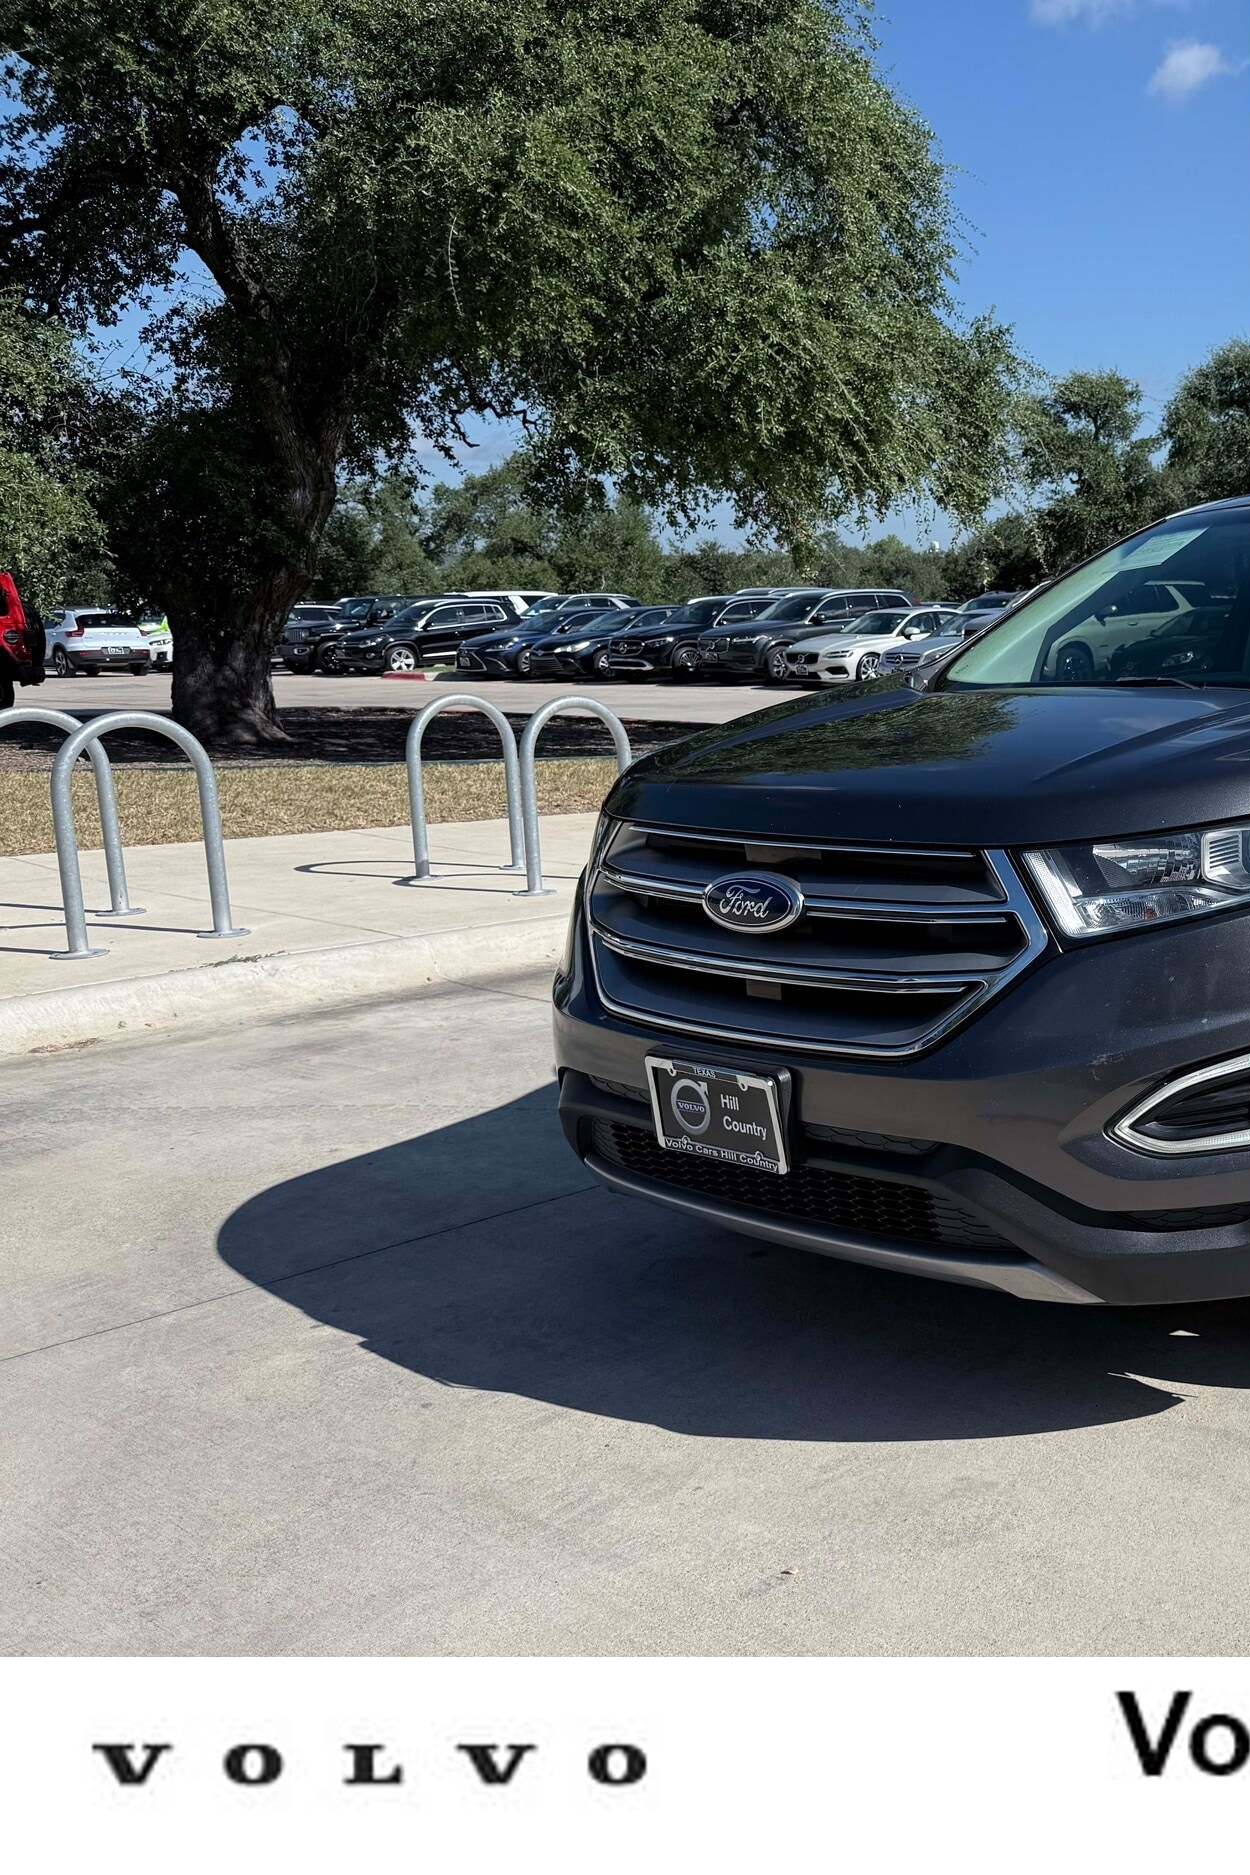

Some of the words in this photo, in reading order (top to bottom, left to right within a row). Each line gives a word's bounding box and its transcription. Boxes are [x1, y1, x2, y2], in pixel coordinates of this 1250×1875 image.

[720, 885, 772, 917] Ford
[693, 1068, 716, 1078] TEXAS
[678, 1102, 705, 1112] VOLVO
[720, 1094, 739, 1110] Hill
[723, 1116, 766, 1140] Country
[665, 1139, 693, 1151] Volvo
[695, 1145, 718, 1157] Cars
[721, 1150, 736, 1161] Hill
[740, 1155, 778, 1171] Country
